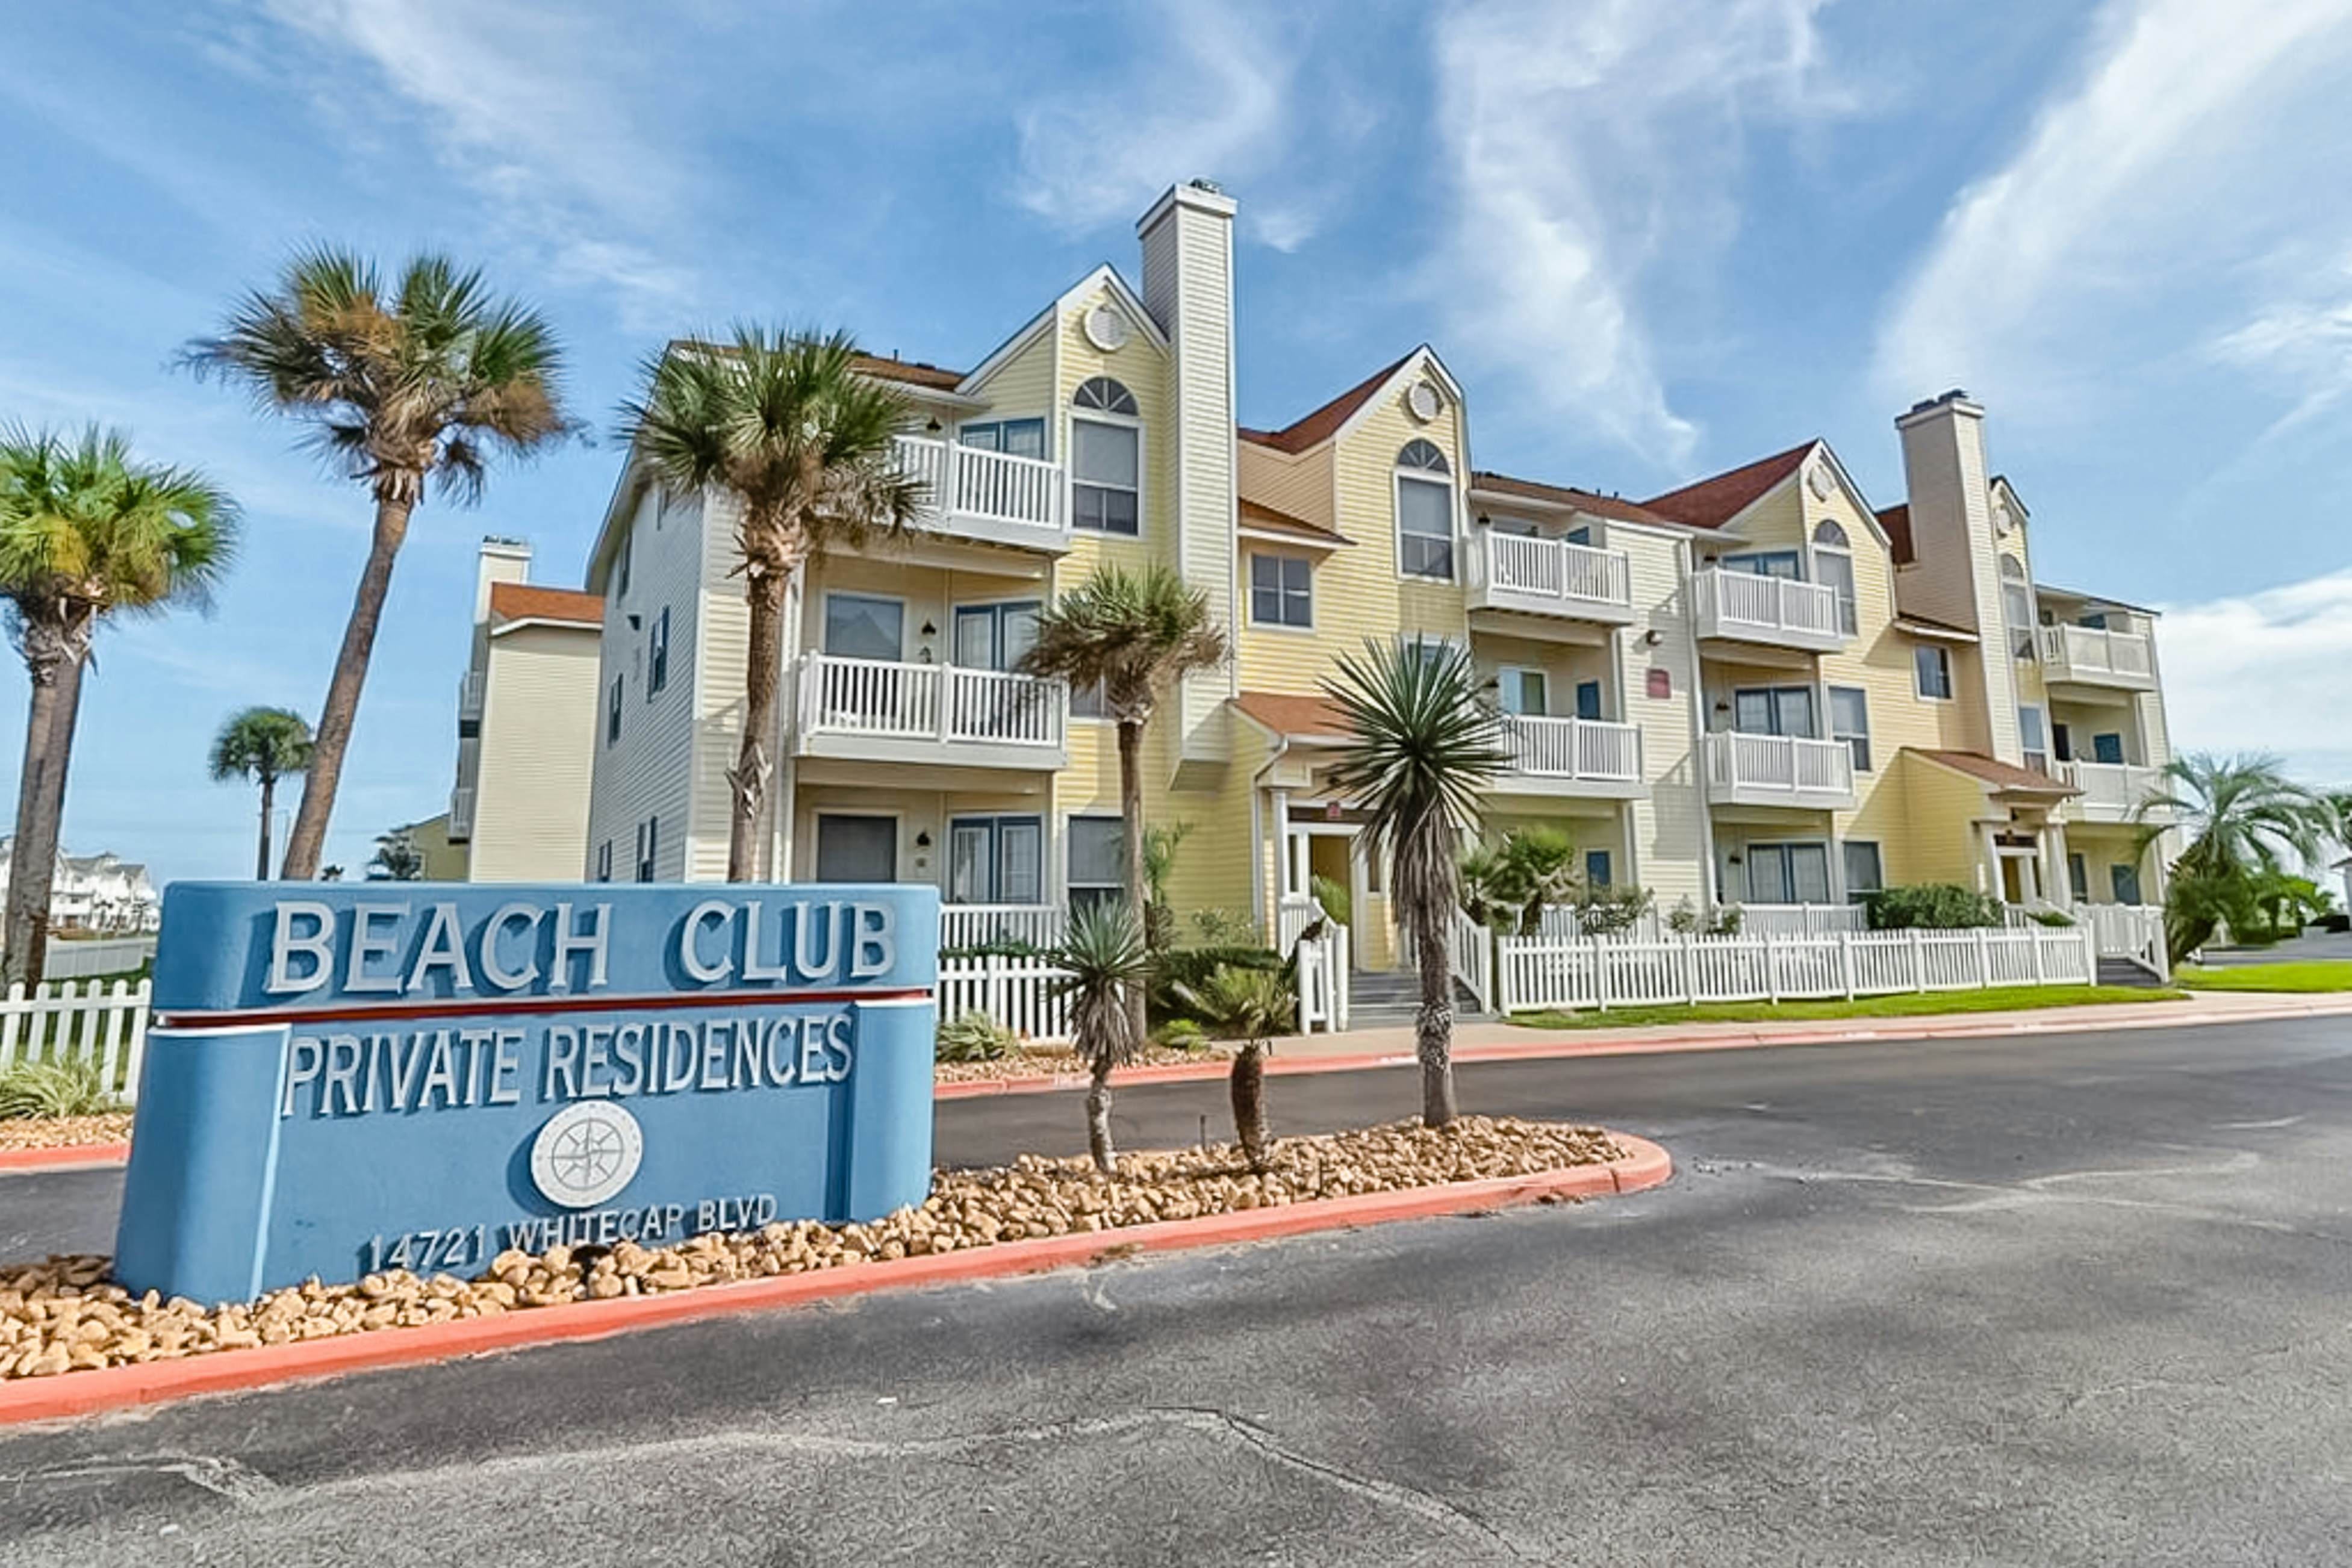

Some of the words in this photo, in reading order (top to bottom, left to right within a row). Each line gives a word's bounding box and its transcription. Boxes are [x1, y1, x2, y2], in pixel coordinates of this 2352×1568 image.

[265, 900, 612, 995] BEACH
[680, 901, 897, 983] CLUB
[281, 1028, 526, 1116] PRIVATE
[544, 1013, 853, 1101] RESIDENCES
[369, 1225, 485, 1271] 14721
[508, 1203, 683, 1252] WHITECAP
[697, 1195, 778, 1232] BLVD
